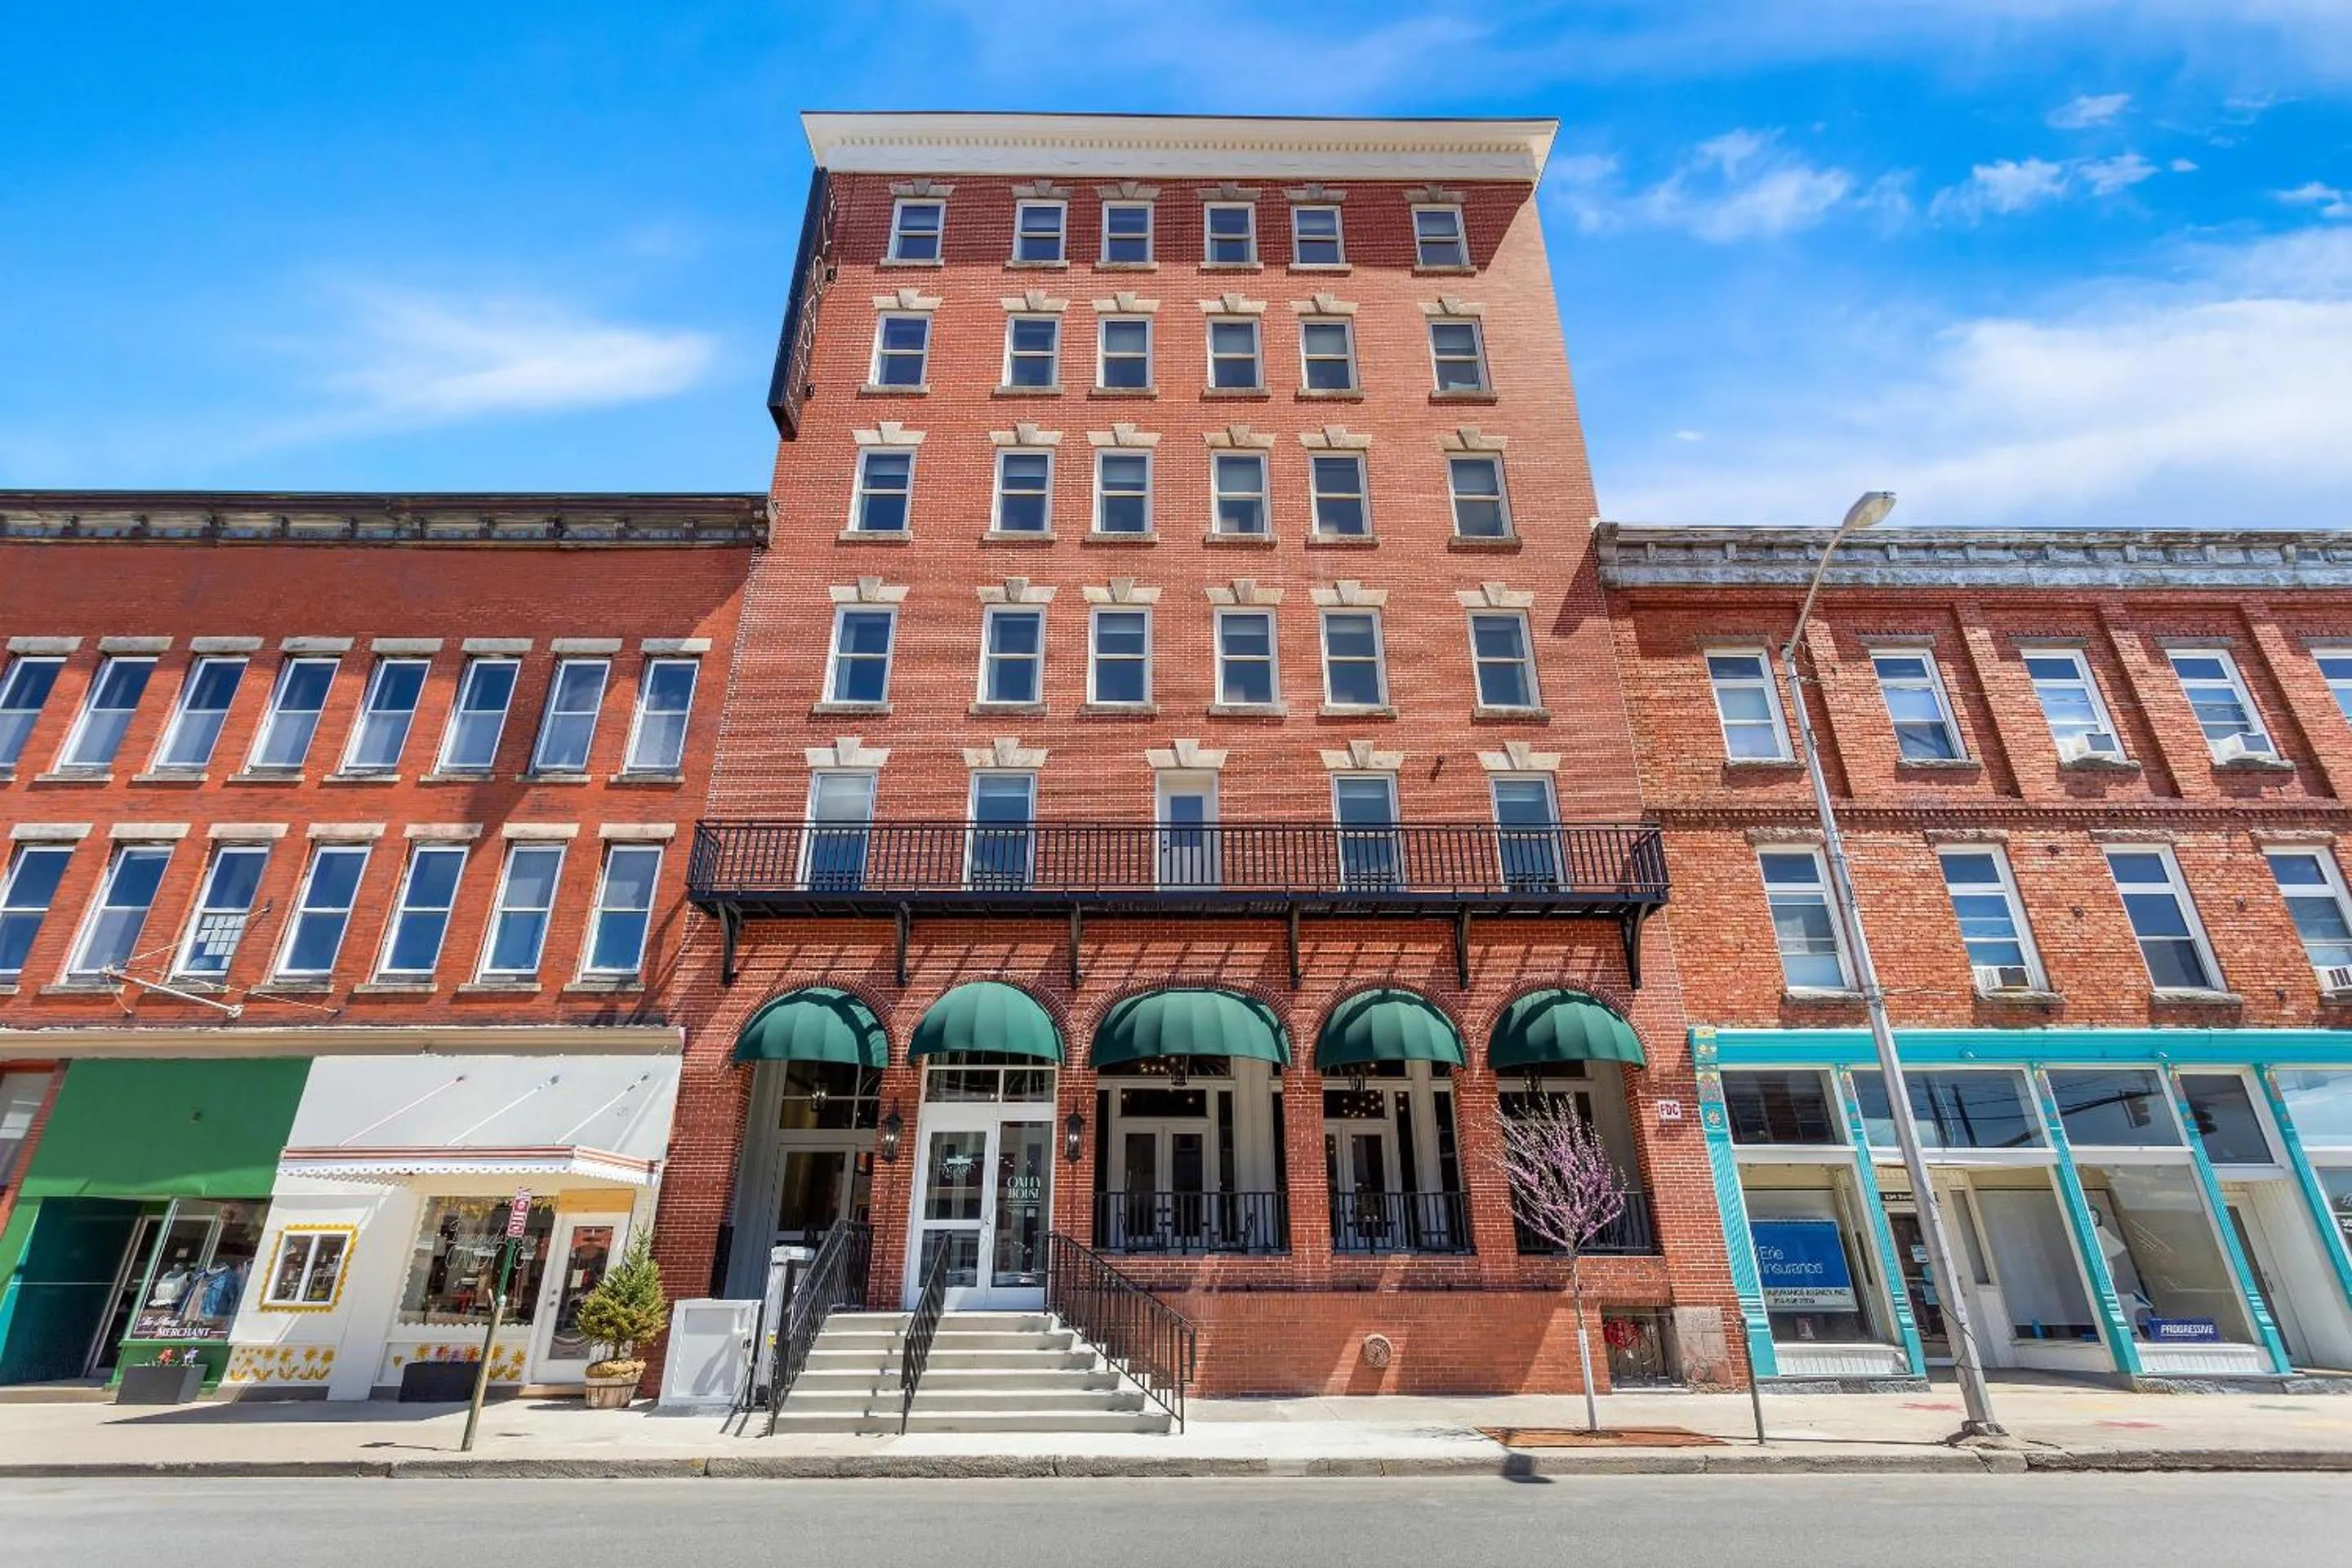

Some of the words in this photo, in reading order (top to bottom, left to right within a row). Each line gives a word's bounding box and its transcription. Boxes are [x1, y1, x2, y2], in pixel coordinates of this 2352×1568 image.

[1660, 1103, 1679, 1116] FDC
[1007, 1187, 1040, 1199] HOUSE
[1758, 1245, 1784, 1260] Erie
[1760, 1262, 1824, 1274] Insurance
[157, 1327, 212, 1337] MERCHANT
[2160, 1324, 2215, 1334] PROGRESSIVE
